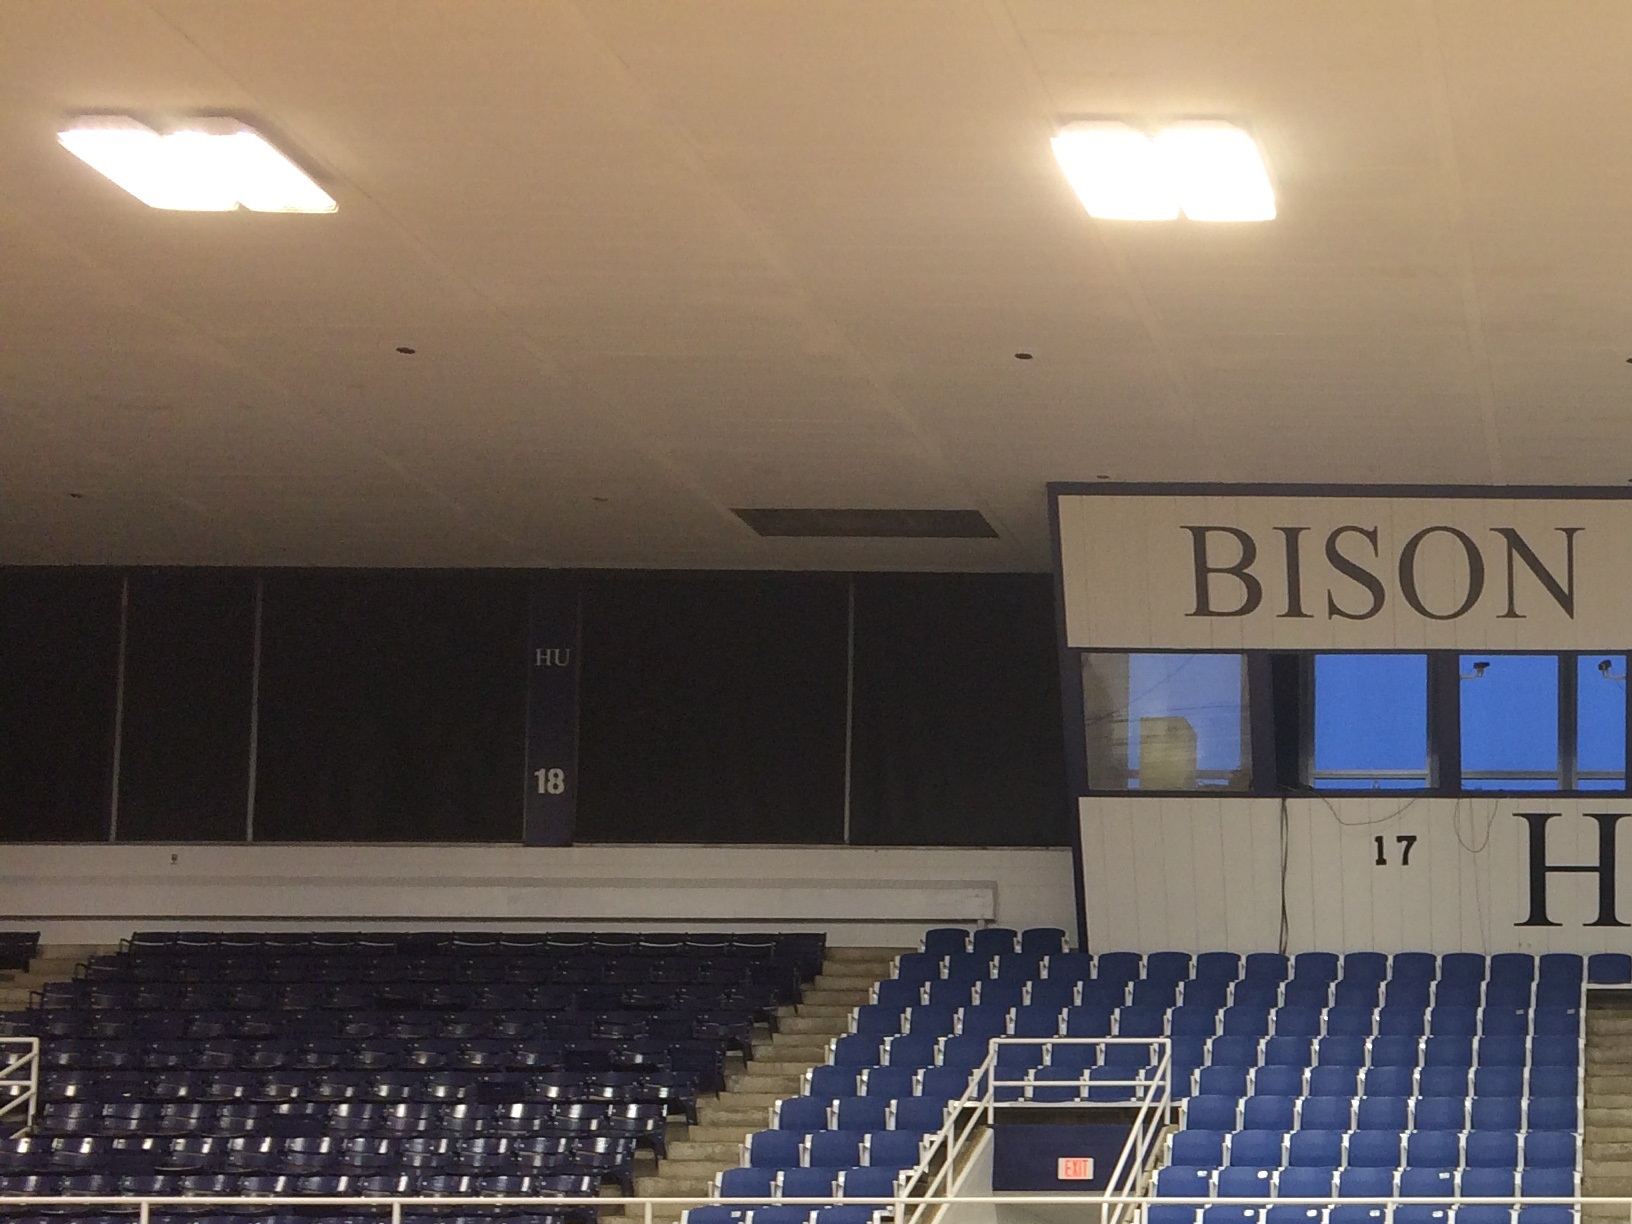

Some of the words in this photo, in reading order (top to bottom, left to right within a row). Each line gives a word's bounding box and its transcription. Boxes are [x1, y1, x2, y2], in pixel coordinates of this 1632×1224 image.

[1179, 524, 1586, 620] BISON
[535, 648, 571, 666] HU
[534, 768, 565, 794] 18
[1374, 835, 1418, 866] 17
[1065, 1159, 1089, 1177] EXIT
